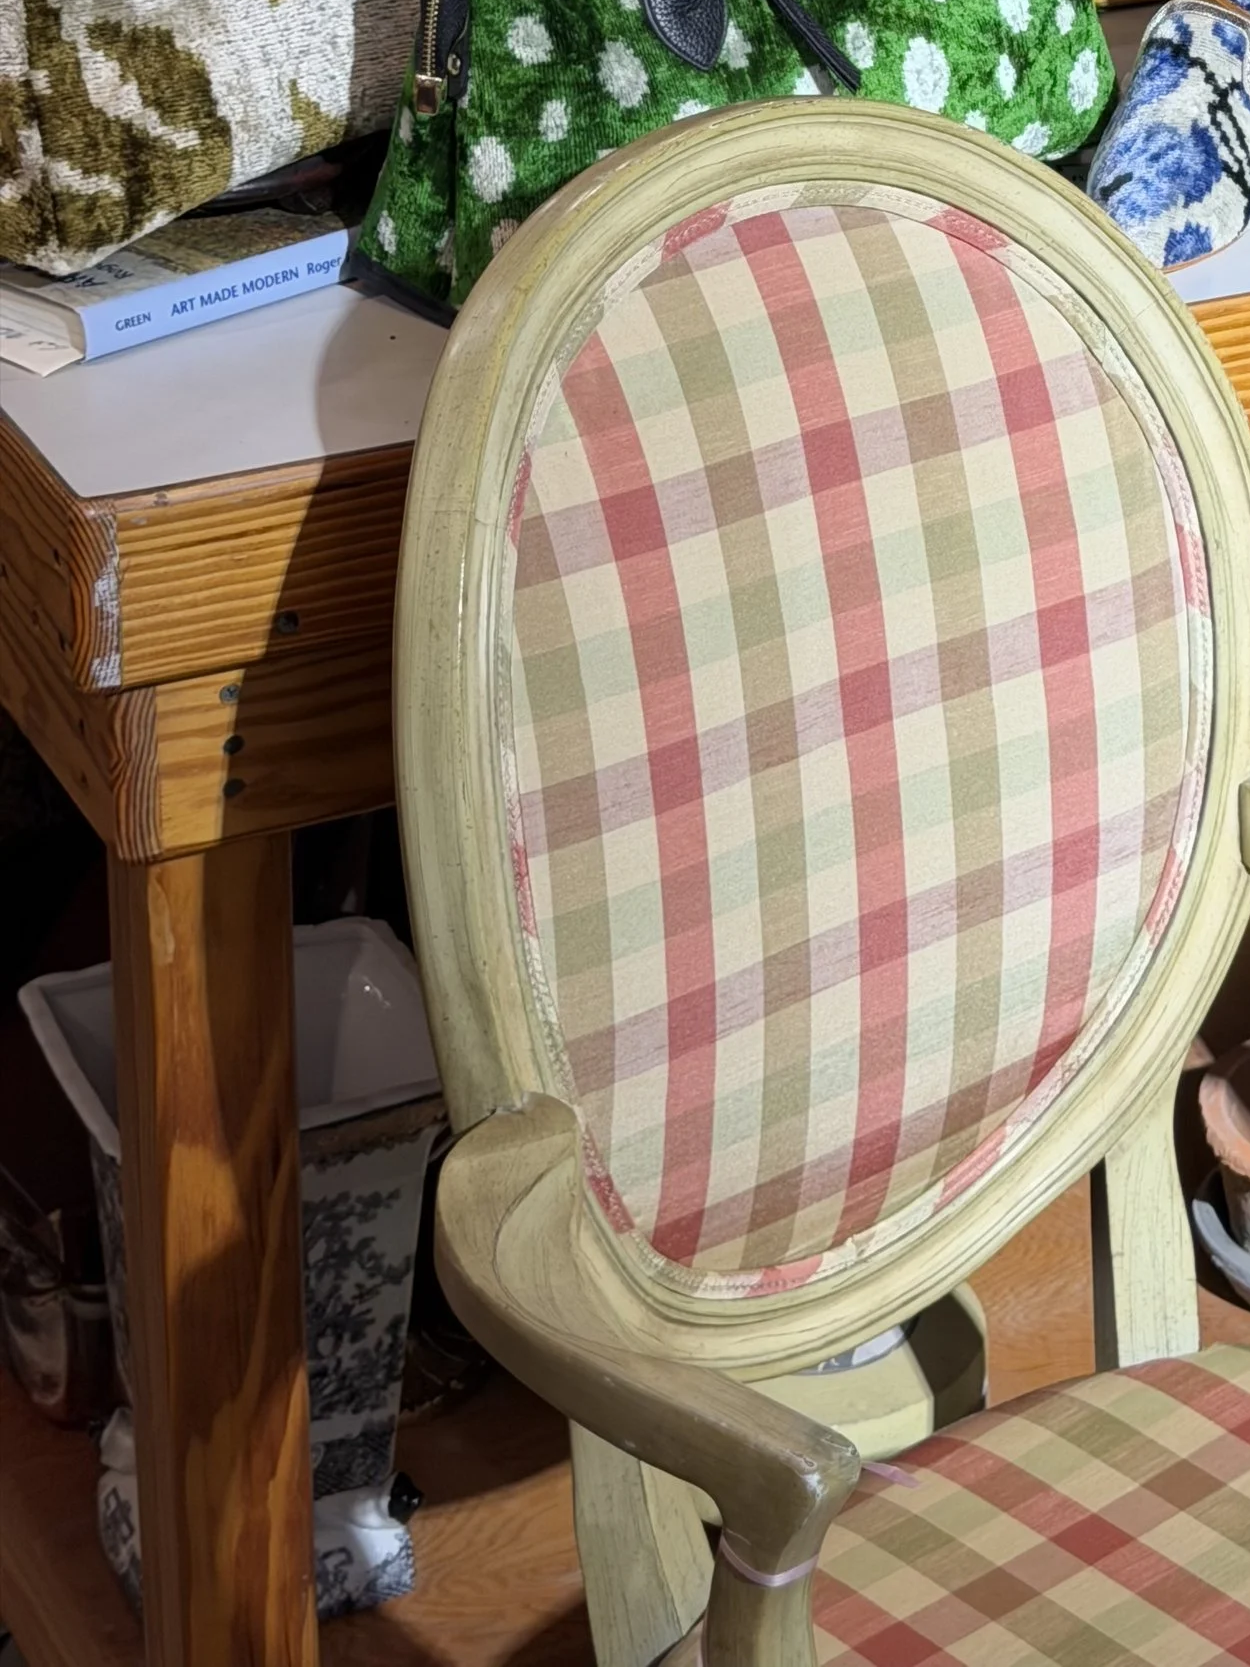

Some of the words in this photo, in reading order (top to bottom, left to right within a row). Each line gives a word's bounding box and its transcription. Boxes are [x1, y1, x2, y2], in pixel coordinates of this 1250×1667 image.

[115, 311, 152, 332] GREEN
[170, 297, 197, 317] ART
[199, 284, 239, 308] MADE
[242, 266, 300, 295] MODERN
[306, 256, 342, 276] Roger
